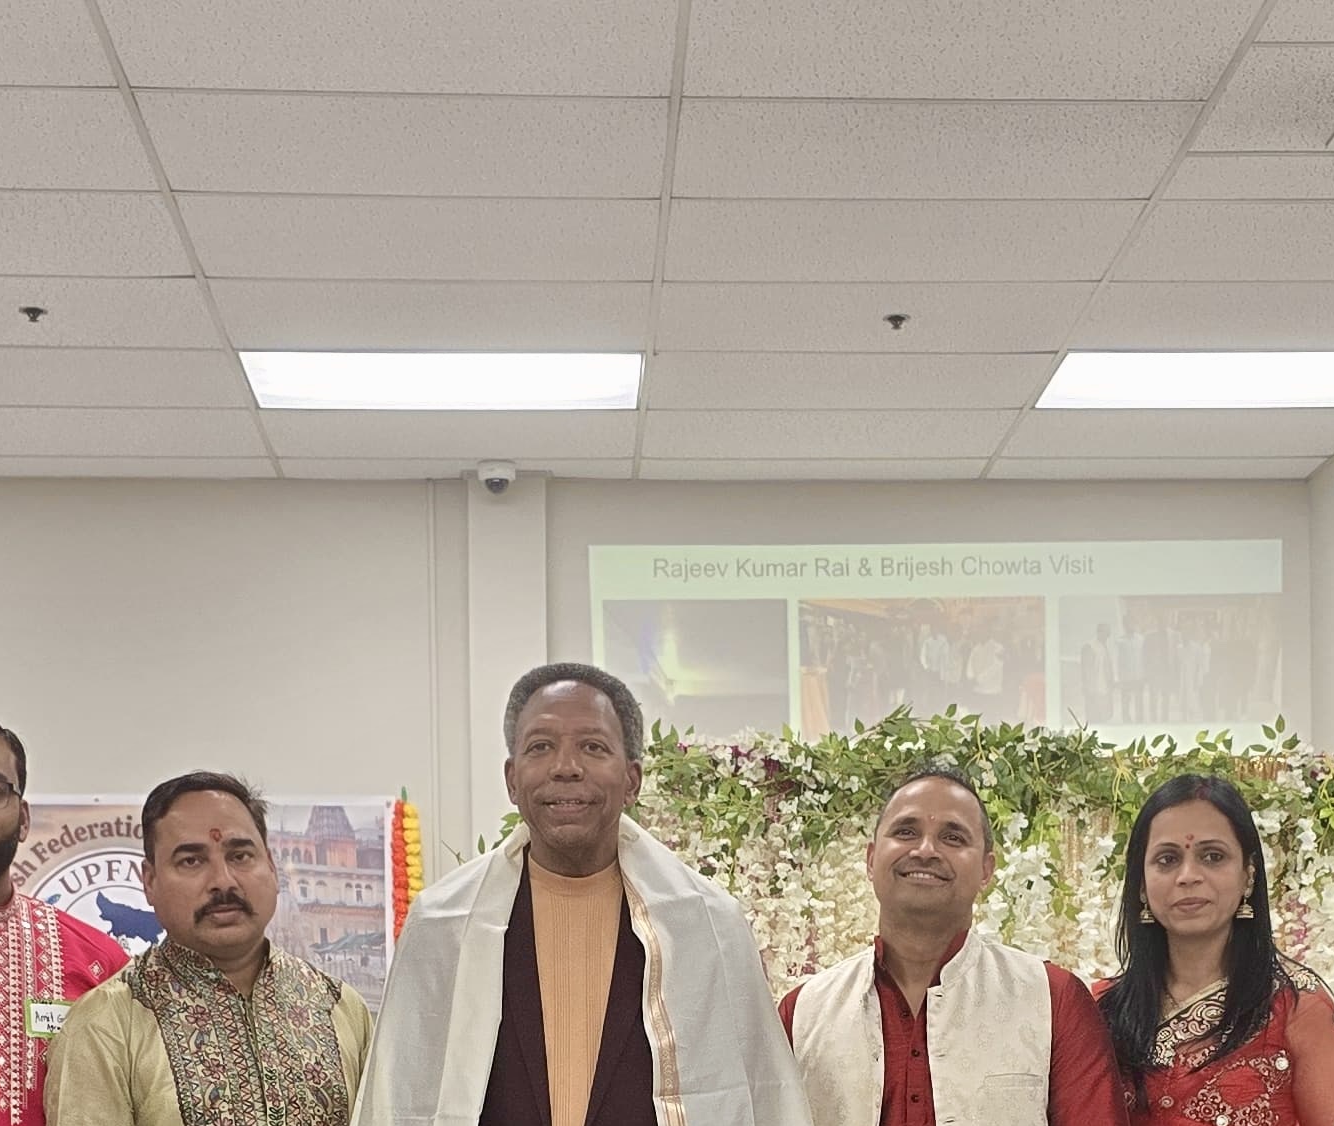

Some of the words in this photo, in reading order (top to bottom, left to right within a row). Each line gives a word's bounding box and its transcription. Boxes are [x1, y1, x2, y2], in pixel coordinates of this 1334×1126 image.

[652, 557, 728, 583] Rajeev
[736, 557, 807, 578] Kumar
[815, 556, 850, 577] Rai
[858, 556, 873, 577] &
[880, 555, 953, 582] Brijesh
[961, 555, 1042, 577] Chowta
[1049, 554, 1095, 576] Visit
[30, 814, 144, 864] Federatio
[58, 859, 144, 895] UPFN
